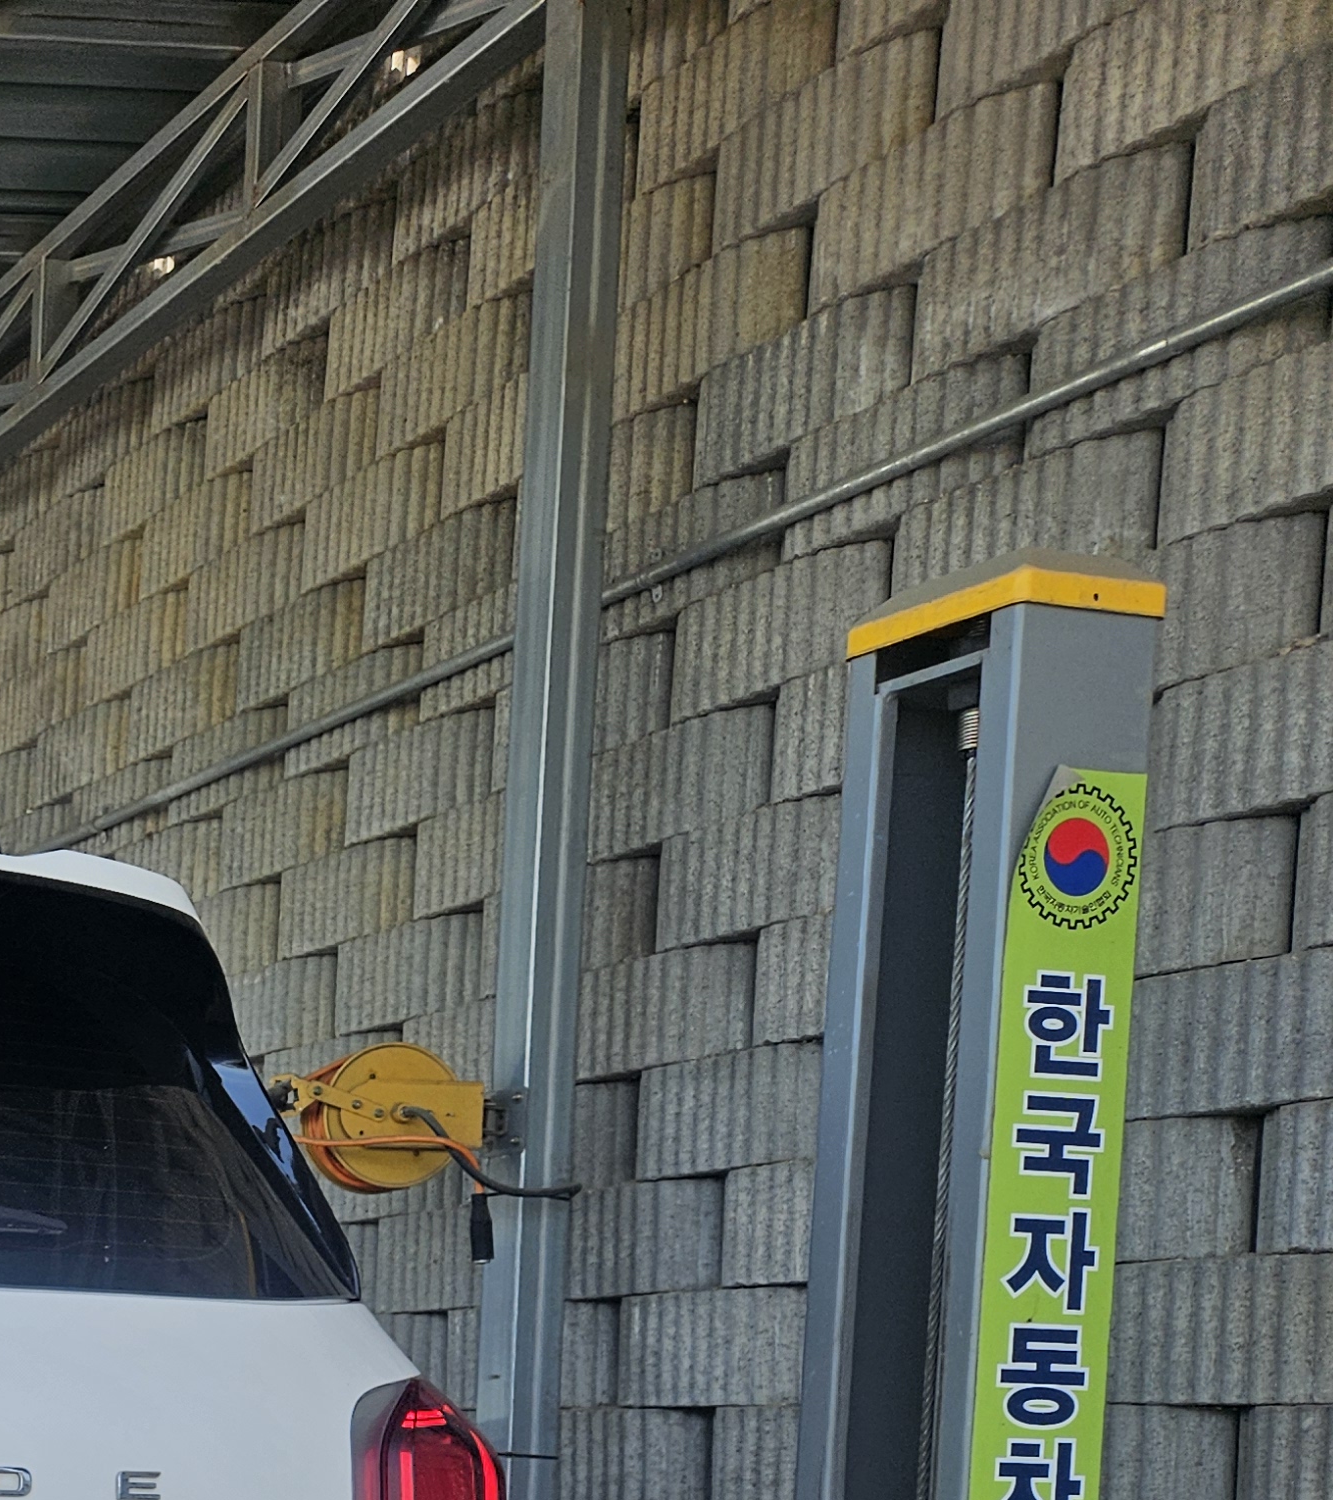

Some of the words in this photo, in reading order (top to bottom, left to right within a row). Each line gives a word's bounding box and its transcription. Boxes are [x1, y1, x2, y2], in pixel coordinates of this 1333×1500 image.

[1033, 801, 1076, 844] ASSOCIATION
[1078, 800, 1090, 809] OF
[1090, 805, 1111, 824] AUTO
[1109, 824, 1124, 887] TECHNICIANS
